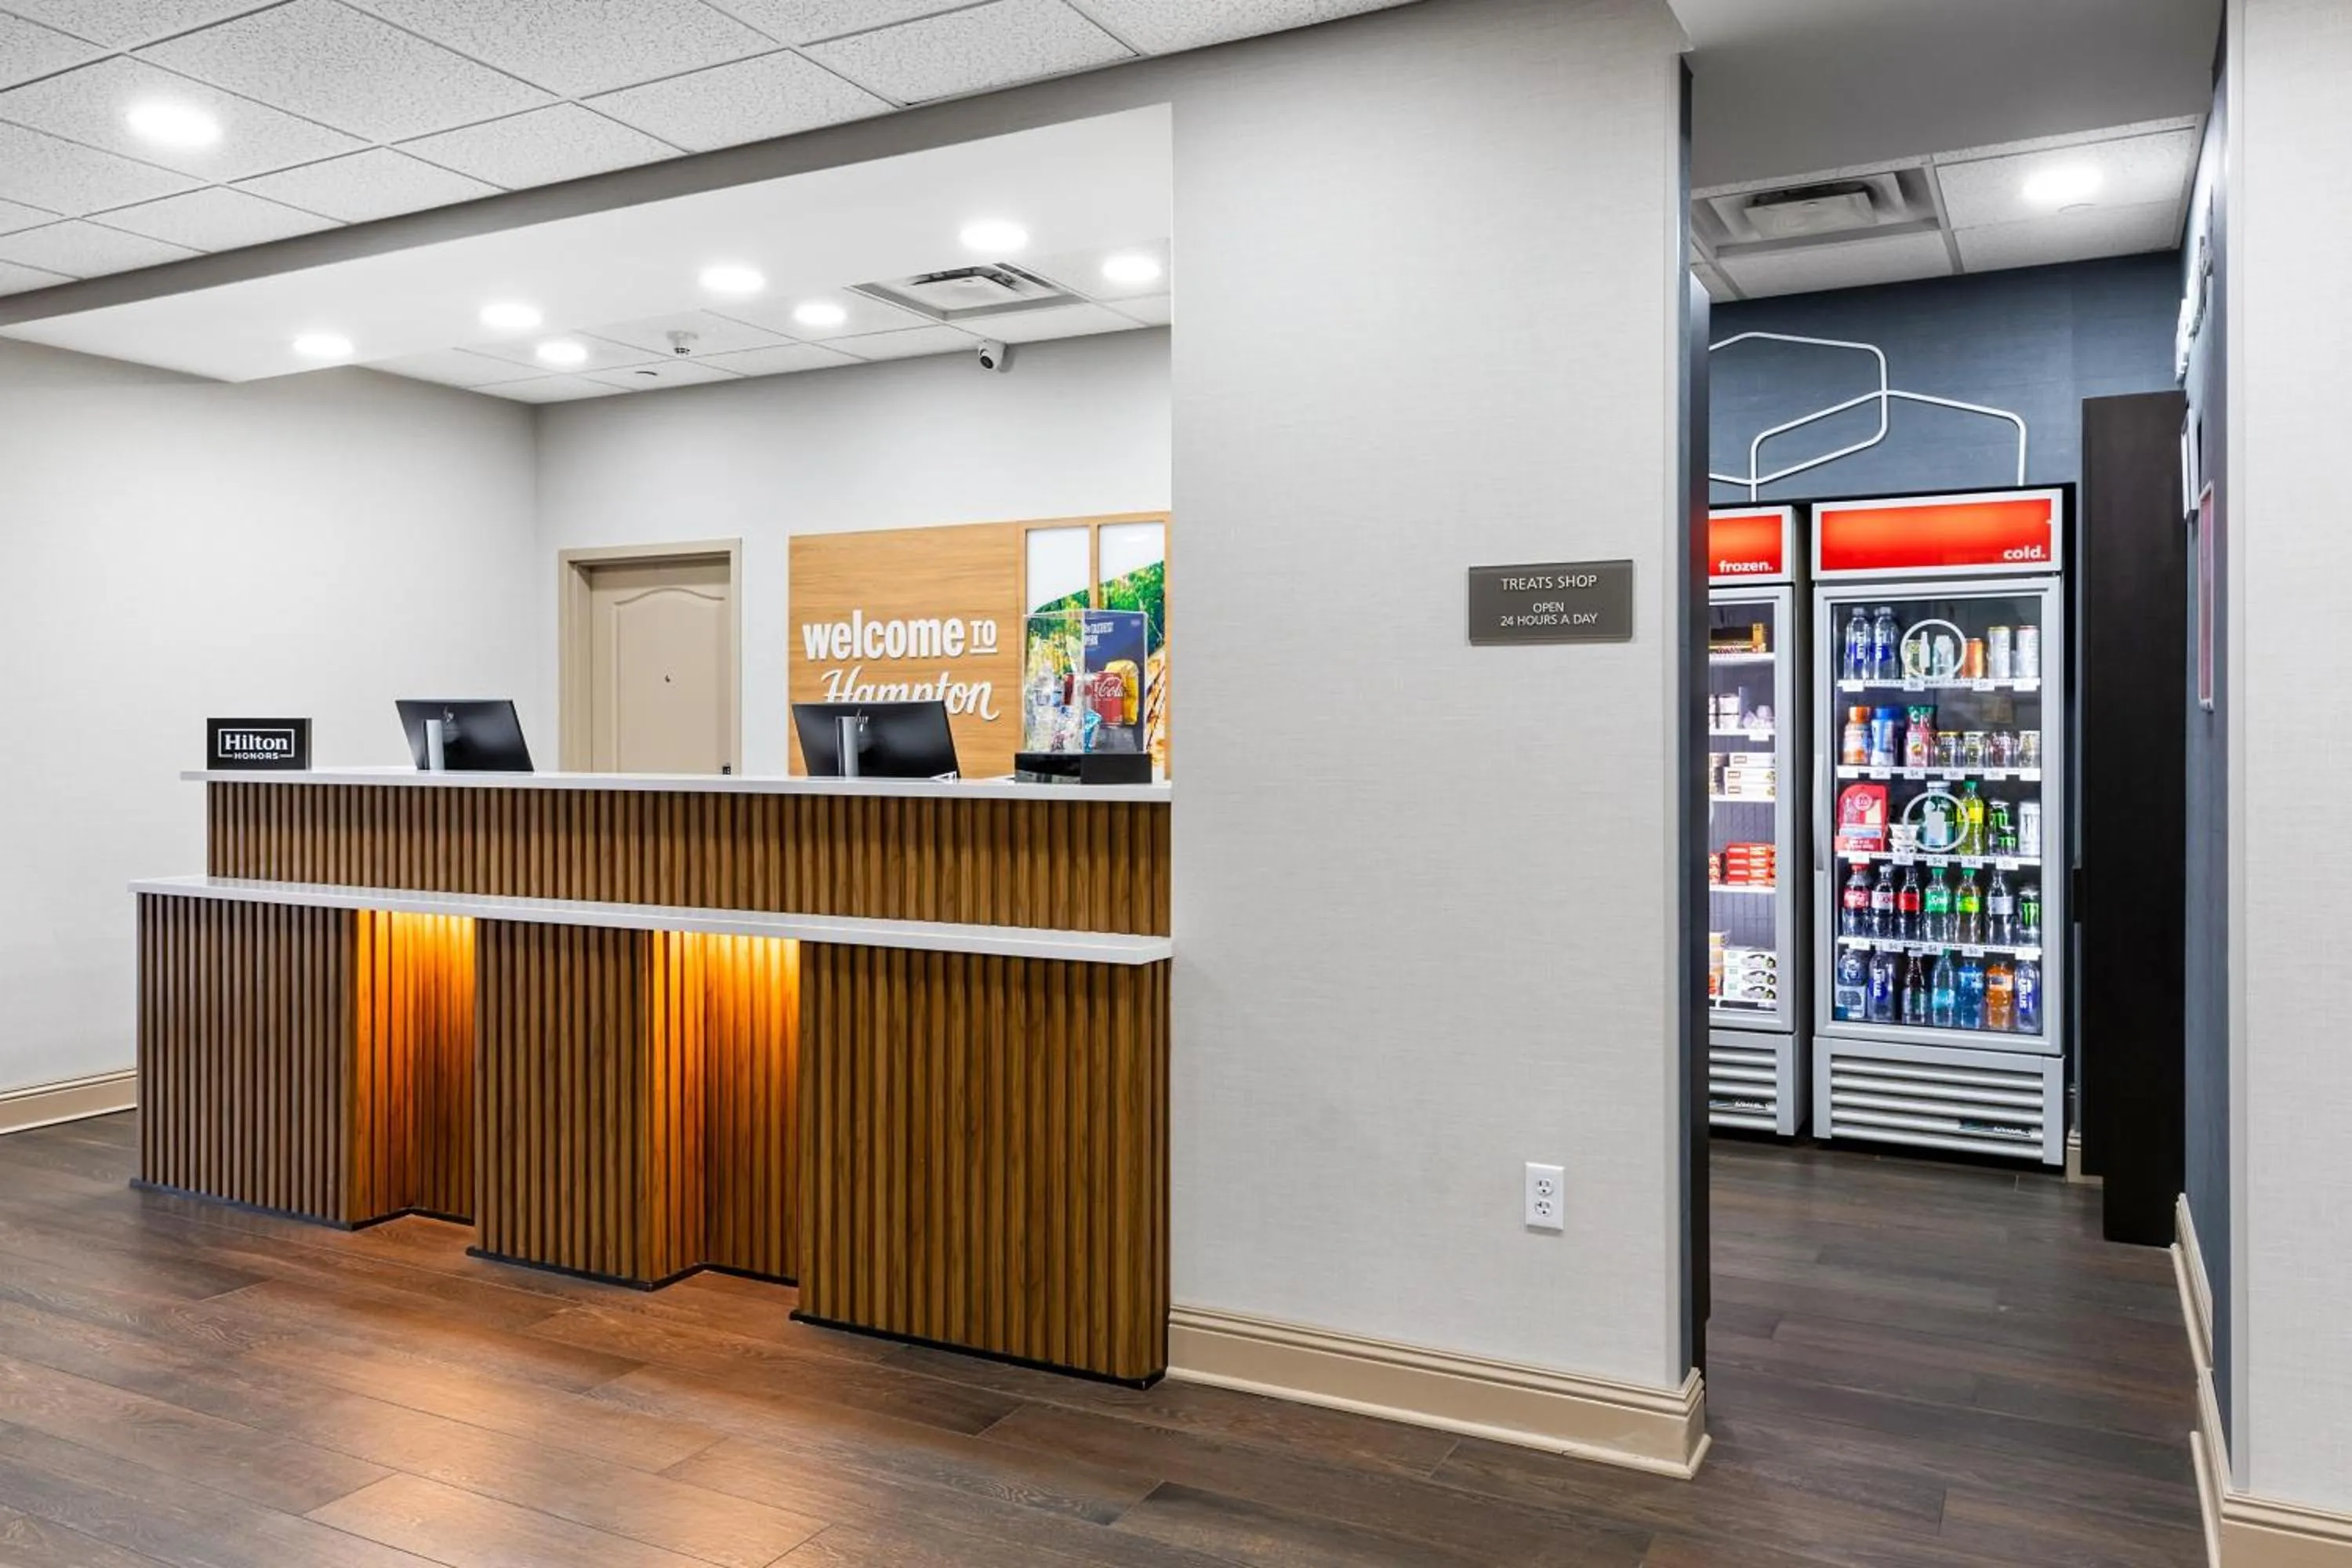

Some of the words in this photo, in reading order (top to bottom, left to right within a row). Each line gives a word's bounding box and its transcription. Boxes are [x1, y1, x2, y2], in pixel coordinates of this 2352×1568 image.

[2003, 545, 2046, 560] cold.
[1719, 559, 1773, 573] frozen.
[1501, 576, 1553, 590] TREATS
[1558, 575, 1597, 588] SHOP
[1533, 602, 1564, 613] OPEN
[1500, 615, 1514, 626] 24
[1517, 614, 1557, 626] HOURS
[1560, 614, 1570, 625] A
[1573, 613, 1598, 625] DAY
[802, 610, 965, 660] welcome
[970, 619, 997, 648] TO
[225, 734, 289, 750] Hilton
